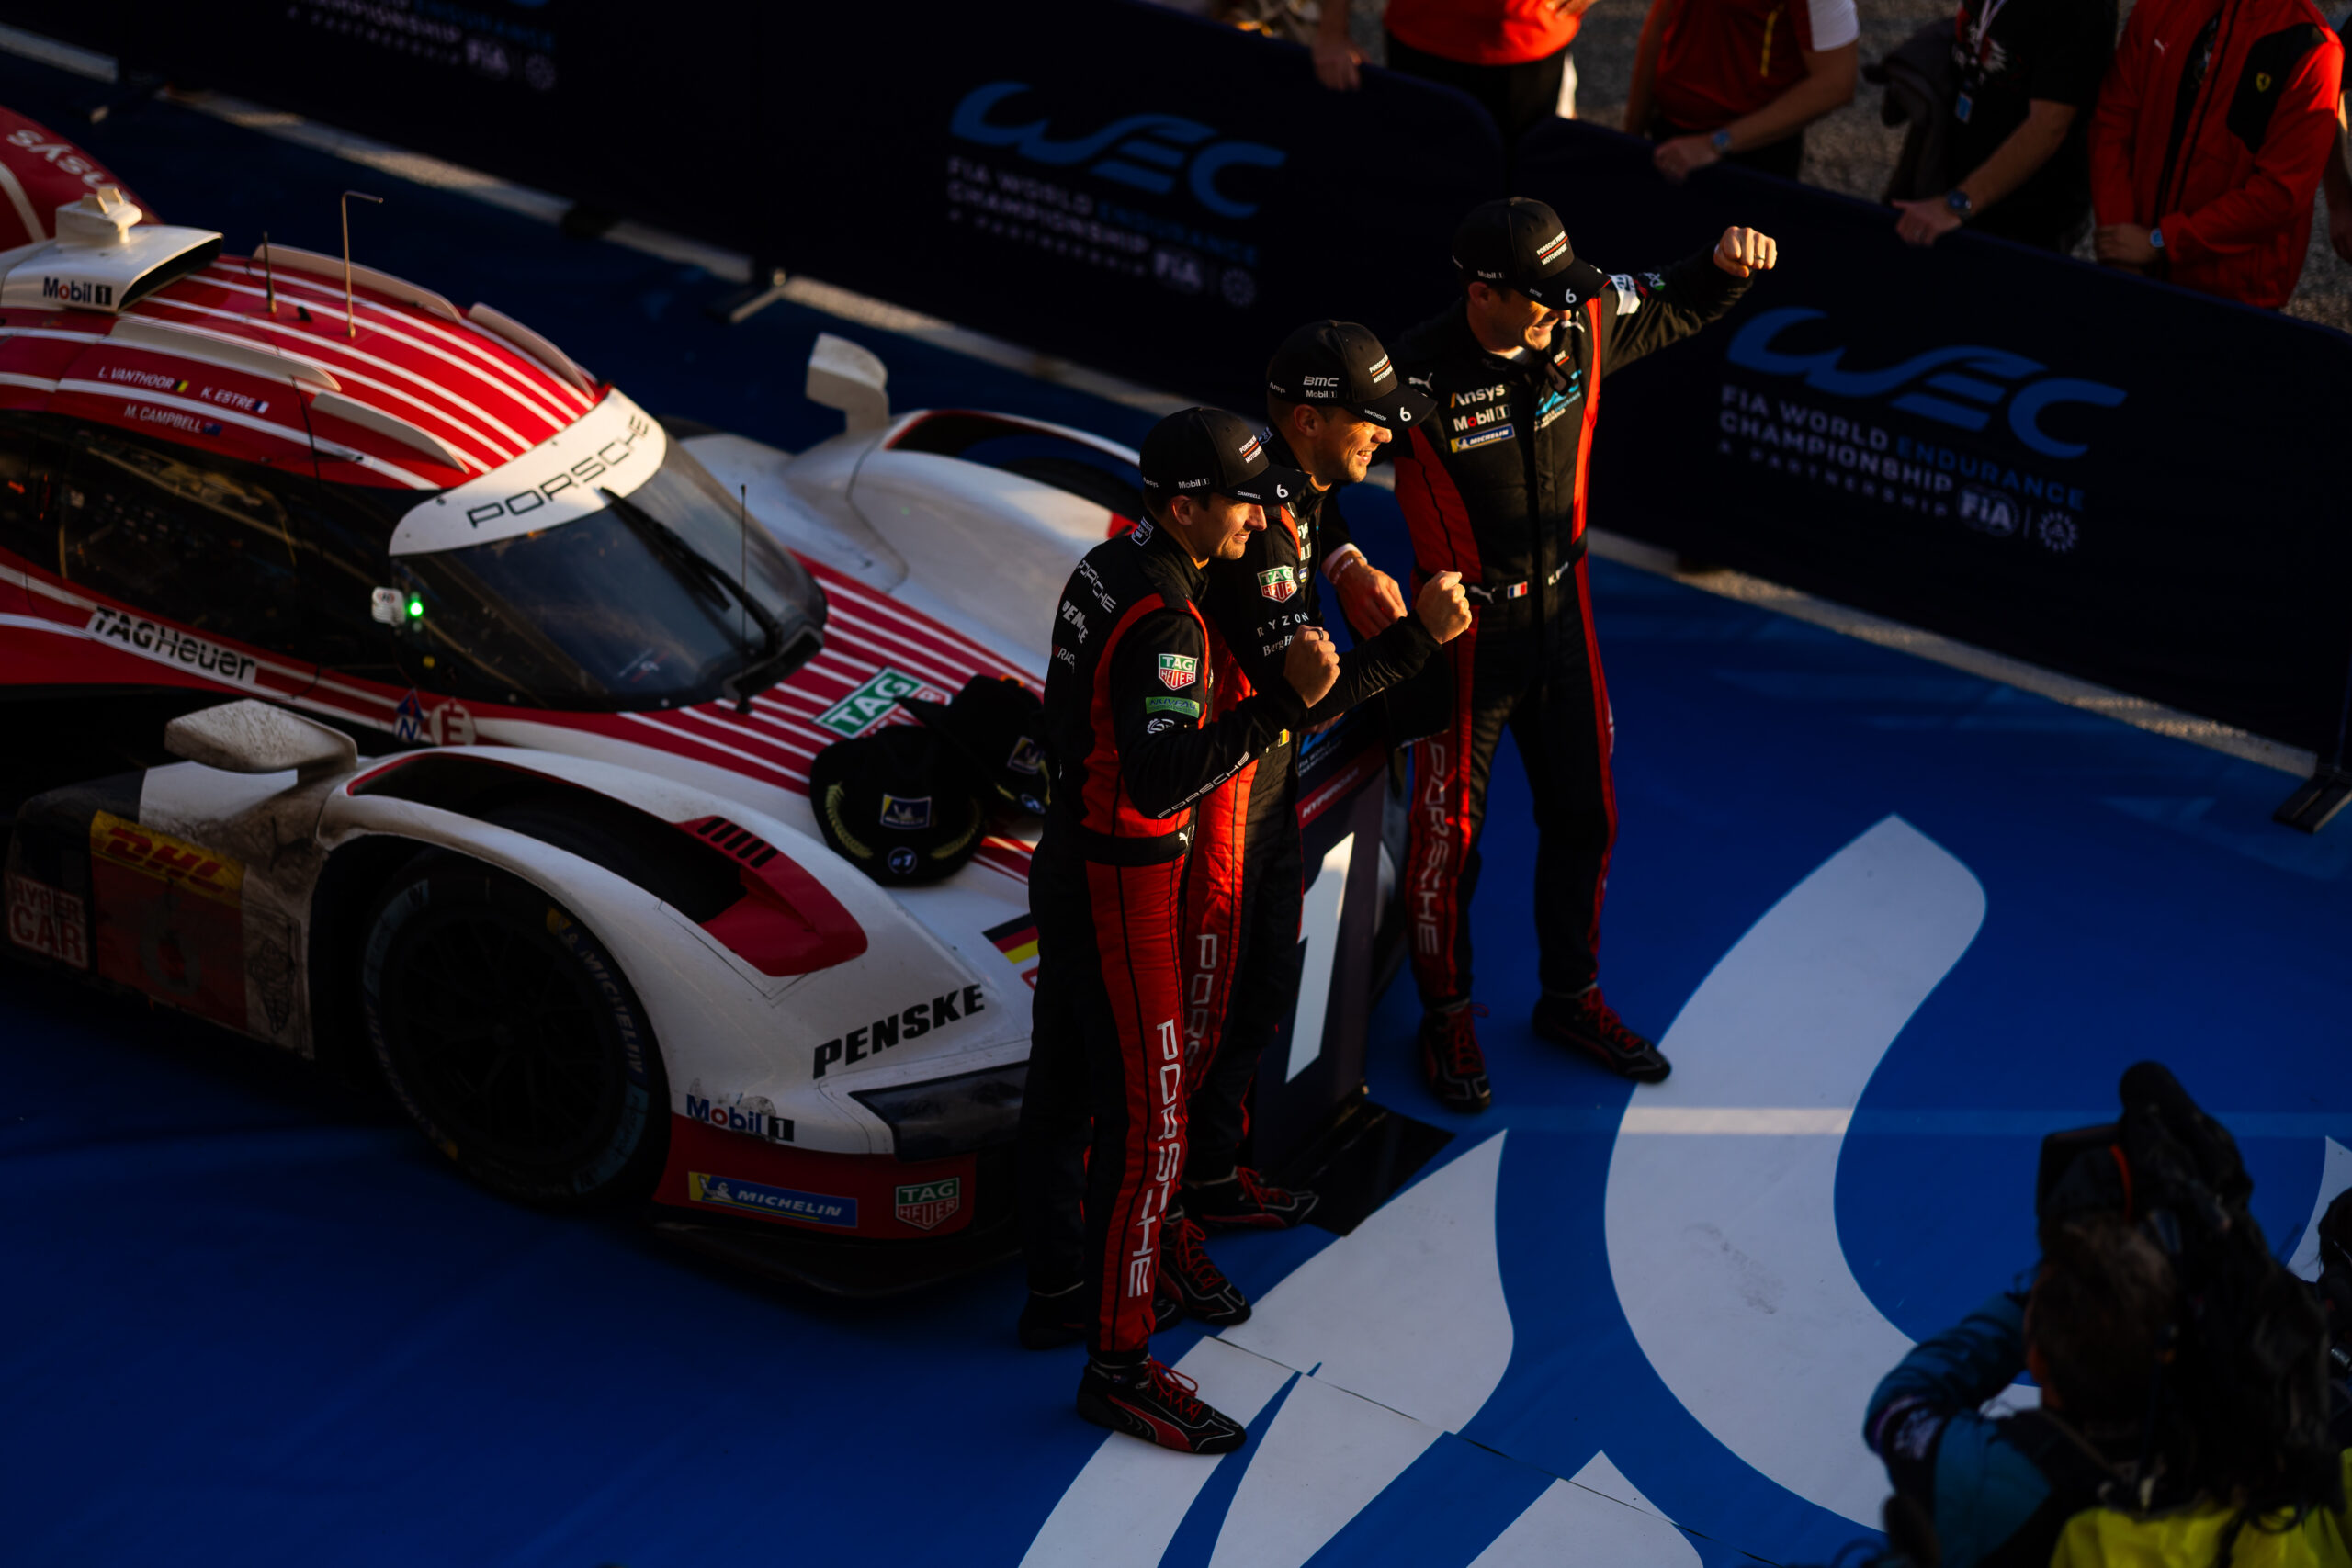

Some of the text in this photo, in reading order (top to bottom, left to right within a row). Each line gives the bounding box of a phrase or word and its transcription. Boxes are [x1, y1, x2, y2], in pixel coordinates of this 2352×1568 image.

[43, 277, 91, 303] Mobil
[1565, 288, 1577, 304] 6
[110, 367, 176, 390] VANTHOOR
[1303, 376, 1340, 388] BMC
[213, 389, 256, 412] ESTRE
[1306, 389, 1329, 399] Mobil
[1450, 383, 1506, 409] Ansys
[139, 405, 202, 434] CAMPBELL
[1399, 406, 1412, 423] 6
[1453, 411, 1496, 433] Mobil
[1470, 427, 1510, 446] MICHELIN
[1721, 383, 2086, 513] FIA WORLD ENDURANCE
[466, 413, 650, 528] PORSCHE
[1719, 409, 2015, 533] CHAMPIONSHIP FIA
[1178, 479, 1201, 490] Mobil
[1276, 483, 1289, 499] 6
[1261, 568, 1294, 584] TAG
[1257, 611, 1309, 638] RYZON
[1262, 633, 1295, 658] BergH
[1162, 655, 1194, 671] TAG
[1161, 669, 1194, 689] HEUER
[826, 675, 913, 727] TAG
[1157, 750, 1250, 818] PORSCHE
[106, 827, 222, 886] DHL
[892, 853, 912, 868] #1
[1417, 740, 1452, 958] PORSCHE
[12, 878, 81, 922] HYPER
[12, 904, 84, 964] CAR
[1285, 831, 1338, 1084] 1
[578, 949, 644, 1075] MICHELIN
[813, 983, 985, 1080] PENSKE
[686, 1092, 795, 1142] Mobil 1
[1127, 1017, 1187, 1299] PORSCHE
[737, 1189, 842, 1217] MICHELIN
[900, 1179, 955, 1202] TAG
[899, 1197, 957, 1224] HEUER
